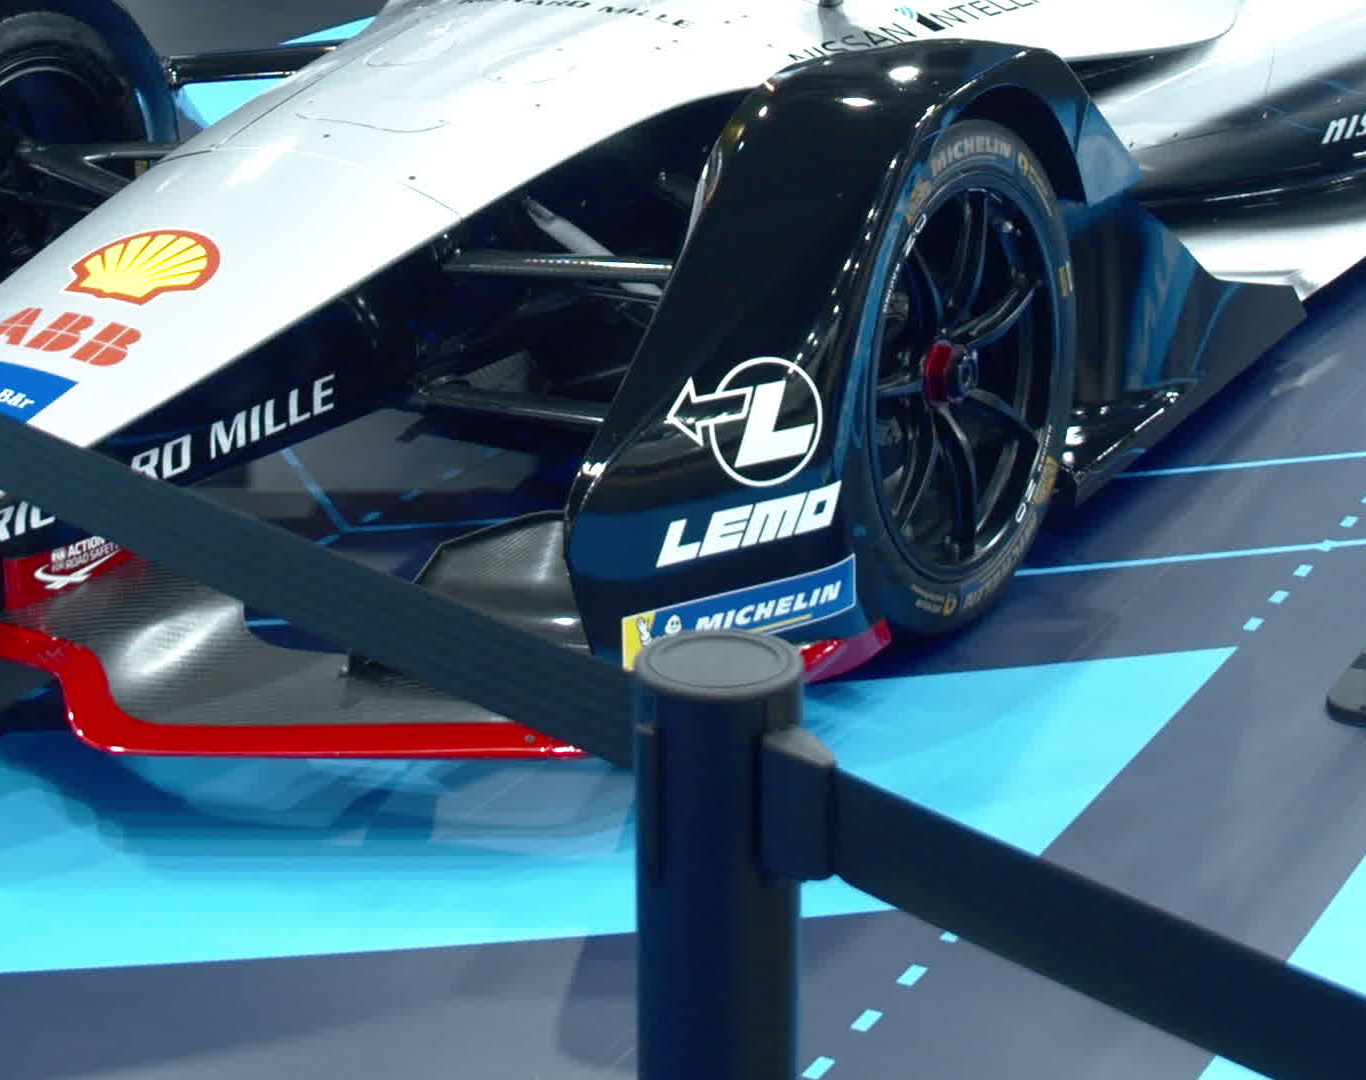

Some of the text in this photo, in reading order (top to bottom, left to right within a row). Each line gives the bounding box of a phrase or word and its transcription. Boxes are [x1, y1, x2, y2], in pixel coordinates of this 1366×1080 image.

[932, 135, 1013, 174] MICHELIN
[209, 373, 335, 460] MILLE
[656, 480, 842, 568] LEMO
[68, 536, 106, 557] ACTION
[90, 542, 119, 560] SAFET
[695, 581, 842, 631] MICHELIN
